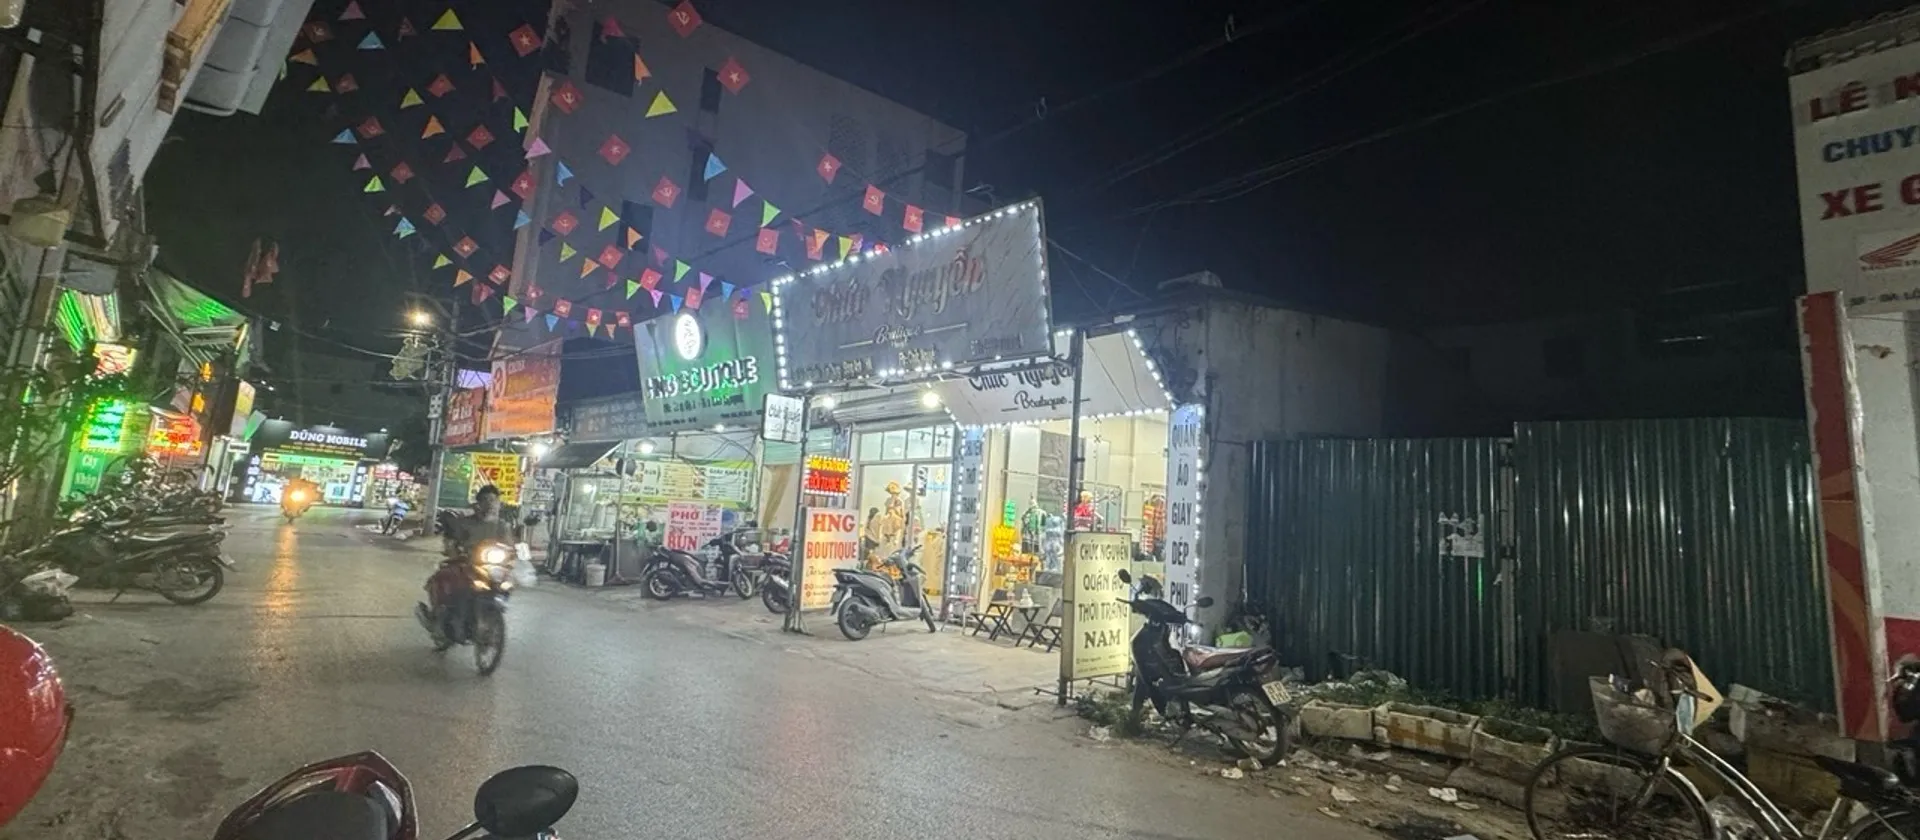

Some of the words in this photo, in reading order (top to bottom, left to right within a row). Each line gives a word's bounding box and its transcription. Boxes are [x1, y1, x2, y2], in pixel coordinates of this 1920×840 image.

[1809, 80, 1868, 122] LÊ
[1822, 125, 1920, 163] CHUY
[1819, 183, 1884, 220] XE
[1014, 391, 1067, 410] Boutique
[326, 435, 368, 449] MOBILE
[1176, 459, 1189, 486] ÁO
[811, 513, 856, 533] HNG
[806, 541, 858, 561] BOUTIQUE
[1171, 536, 1188, 565] DÉP
[1084, 629, 1121, 649] NAM
